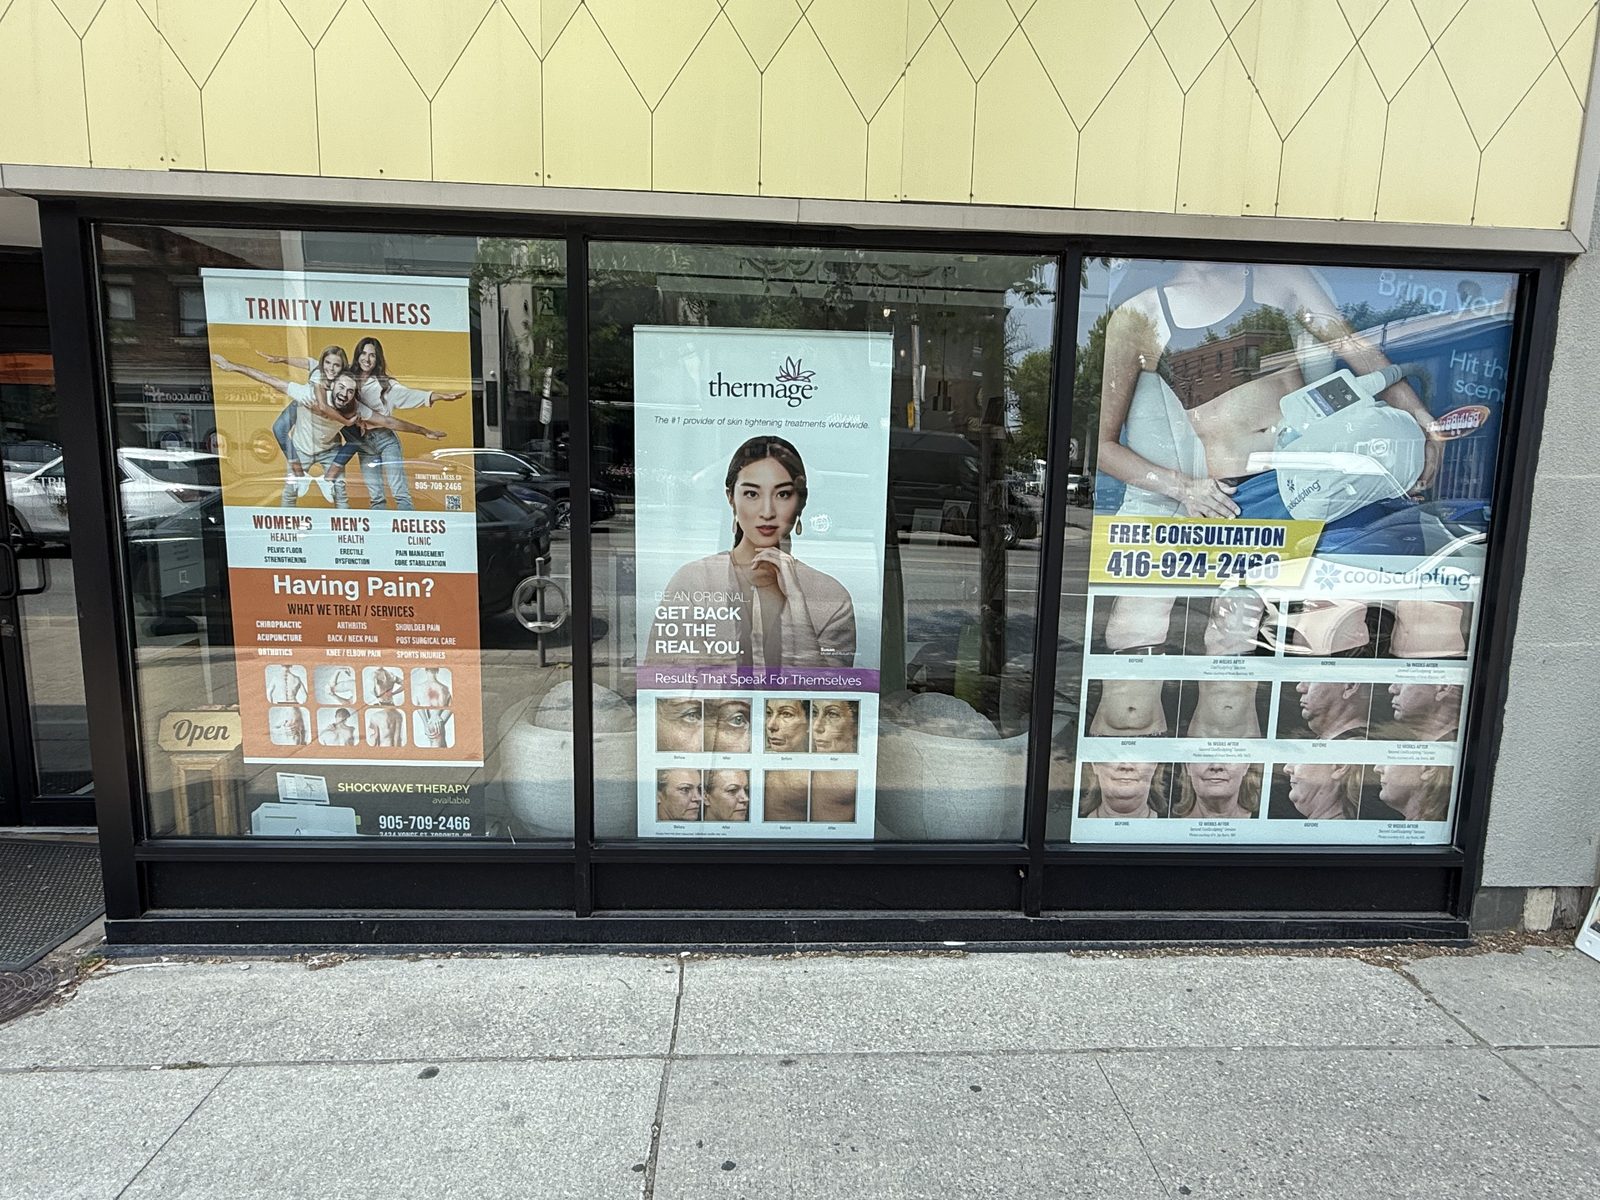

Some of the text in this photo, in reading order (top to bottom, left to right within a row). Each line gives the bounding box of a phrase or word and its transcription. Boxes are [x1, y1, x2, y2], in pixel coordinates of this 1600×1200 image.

[1378, 271, 1447, 310] Bring
[245, 297, 431, 325] TRINITY WELLNESS
[1449, 349, 1480, 375] Hit
[708, 372, 814, 408] thermage
[655, 415, 870, 429] The #1 provider of skin tightening treatments worldwide.
[415, 482, 462, 490] 905-709-2466
[252, 514, 313, 531] WOMEN'S
[330, 516, 370, 532] MEN'S
[392, 518, 446, 534] AGELESS
[270, 533, 298, 542] HEALTH
[337, 535, 365, 544] HEALTH
[407, 536, 432, 546] CLINIC
[1110, 524, 1285, 547] FREE CONSULTATION
[267, 546, 286, 554] PELVIC
[339, 548, 364, 556] ERECTILE
[395, 549, 445, 558] PAIN MANAGEMENT
[264, 556, 307, 564] STRENGTHENING
[394, 559, 408, 567] CORE
[1343, 566, 1472, 591] coolsculpting
[273, 573, 435, 601] Having Pain?
[654, 591, 671, 602] BE
[673, 591, 691, 602] AN
[287, 603, 415, 618] WHAT WE TREAT / SERVICES
[655, 605, 742, 621] GET BACK
[255, 620, 303, 629] CHIROPRACTIC
[336, 621, 368, 630] ARTHRITIS
[395, 623, 441, 632] SHOULDER PAIN
[654, 623, 717, 638] TO THE
[256, 633, 303, 642] ACUPUNCTURE
[327, 634, 343, 642] BACK
[348, 635, 363, 643] NECK
[364, 635, 379, 643] PAIN
[395, 636, 457, 646] POST SURGICAL CARE
[257, 648, 293, 656] ORTHOTICS
[326, 648, 341, 657] KNEE
[346, 649, 368, 657] ELBOW
[368, 649, 382, 658] PAIN
[655, 640, 745, 655] REAL YOU.
[396, 651, 446, 660] SPORTS INJURIES
[655, 672, 862, 688] Results That Speak For Themselves
[172, 719, 230, 747] Open
[337, 782, 471, 794] SHOCKWAVE THERAPY
[432, 796, 471, 805] available
[379, 815, 471, 831] 905-709-2466
